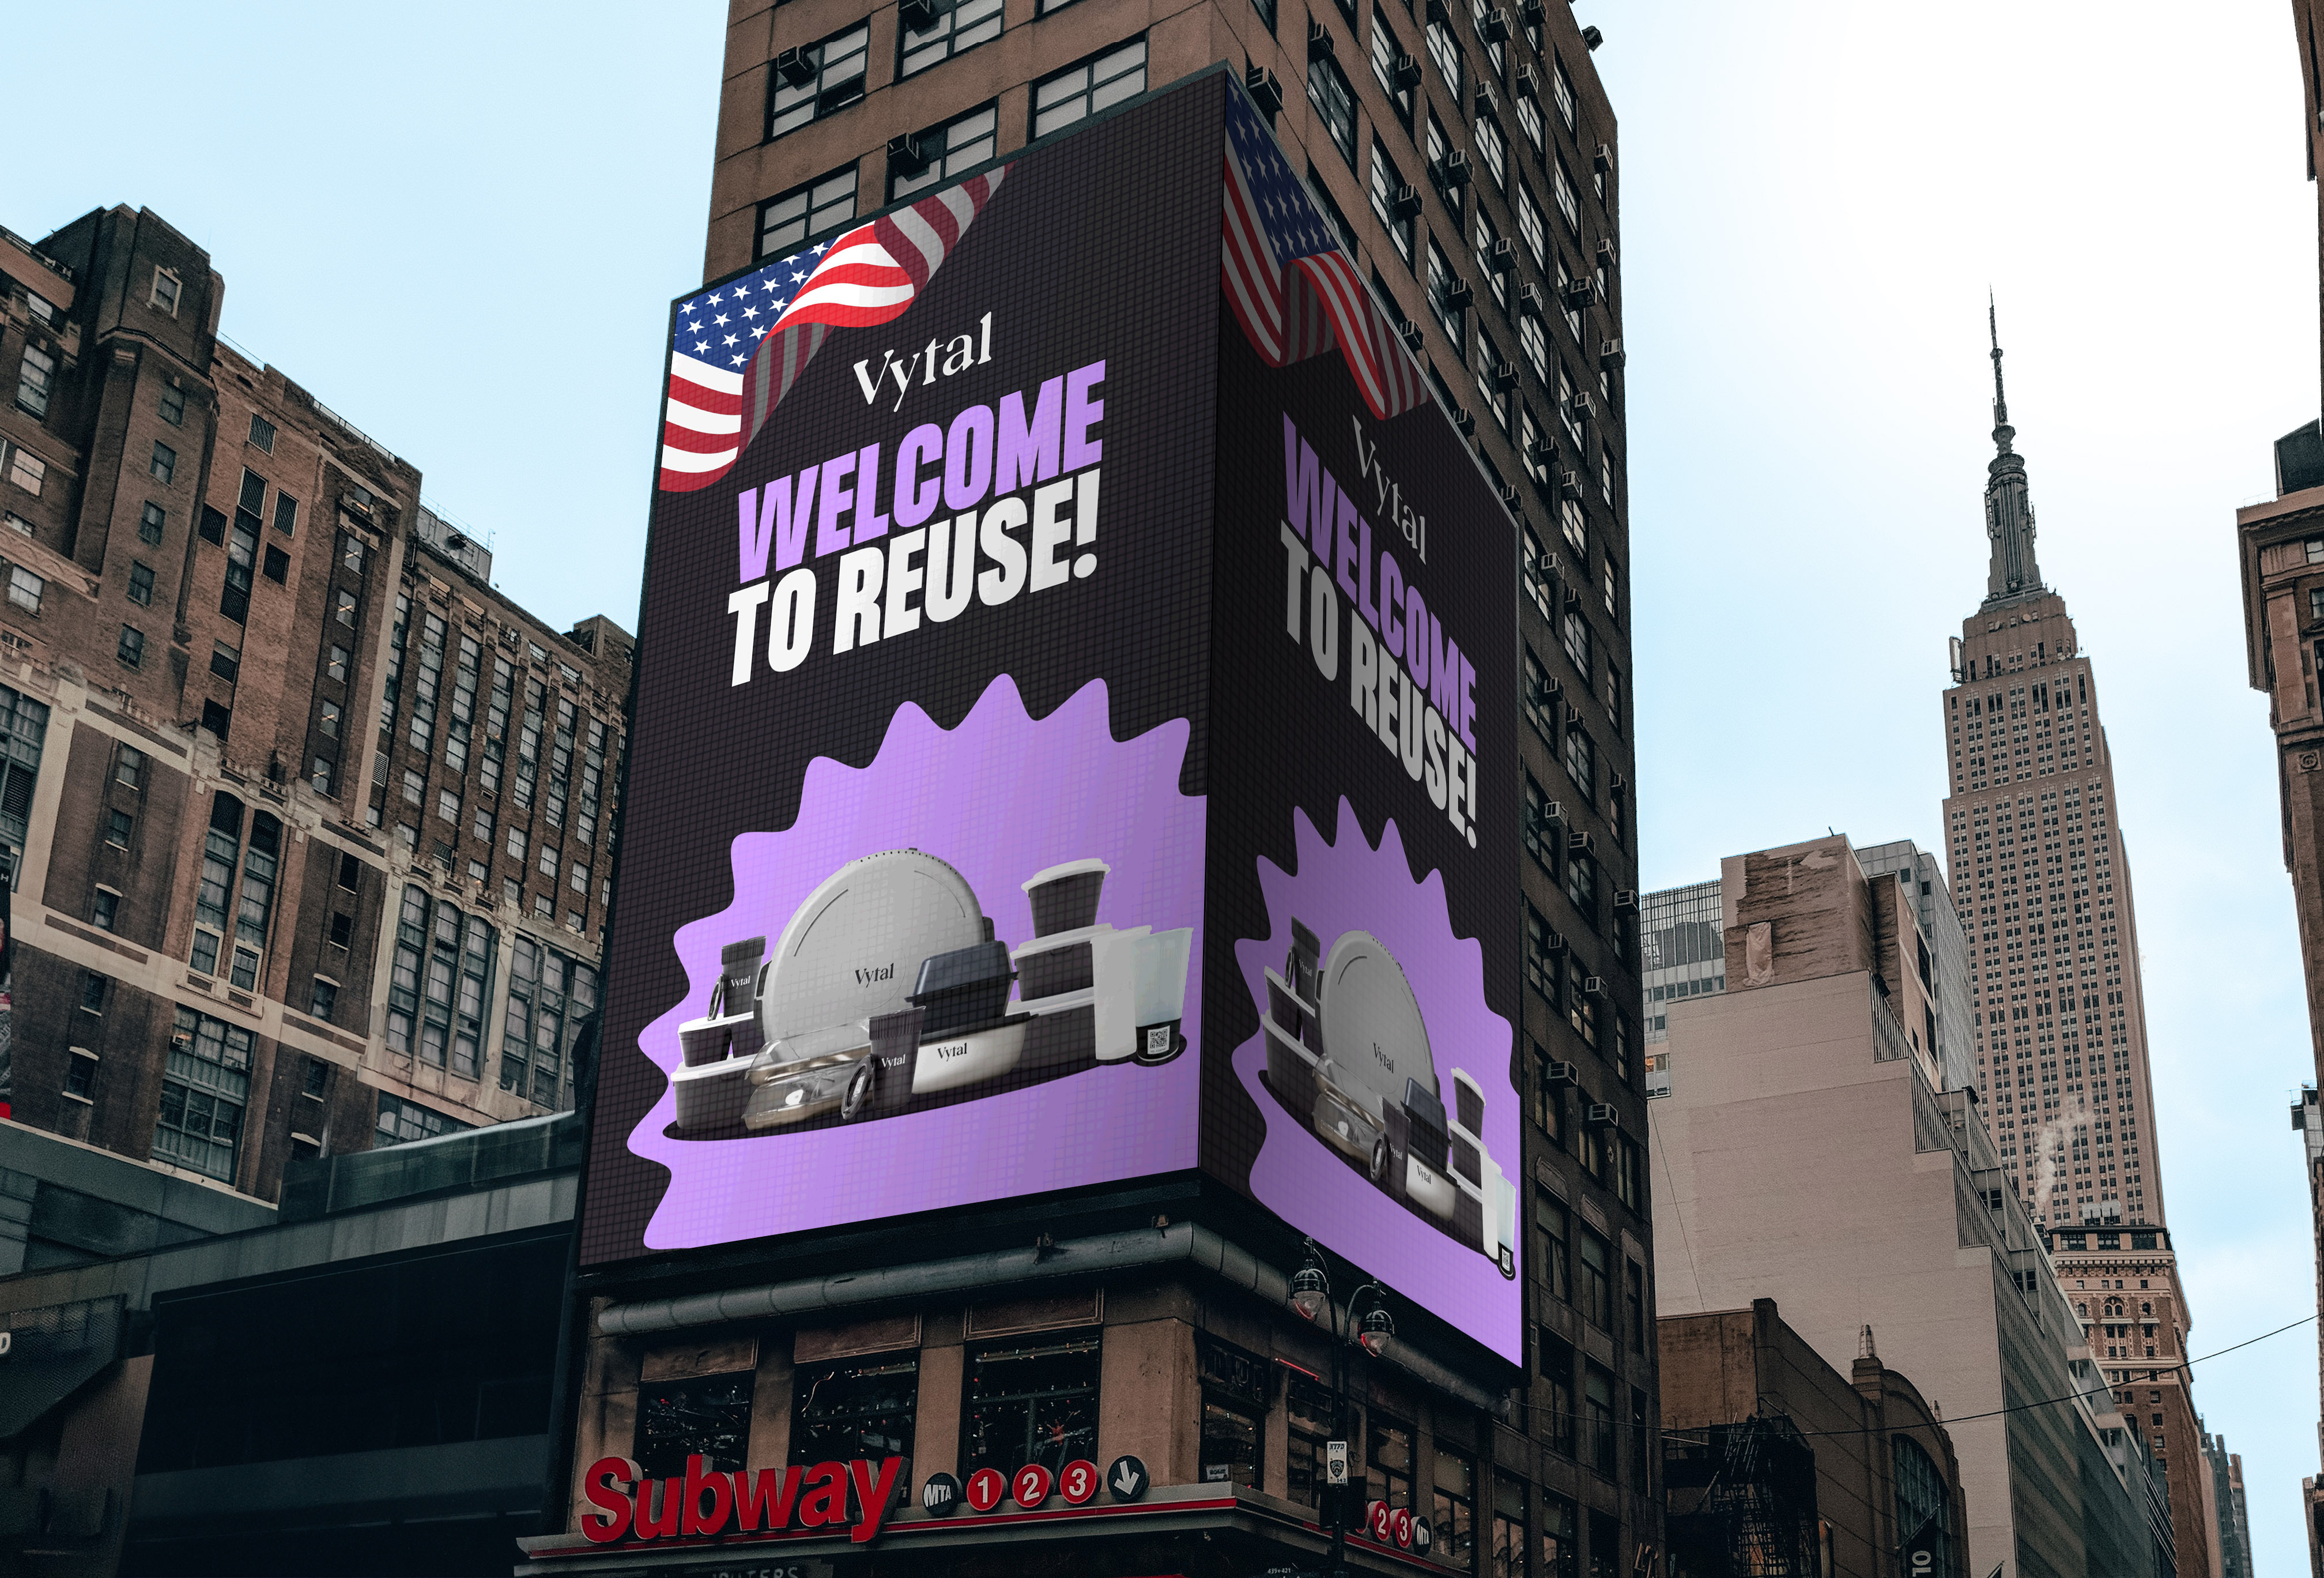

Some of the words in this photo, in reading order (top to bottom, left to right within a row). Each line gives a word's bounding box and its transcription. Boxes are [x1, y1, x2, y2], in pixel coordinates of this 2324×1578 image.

[853, 311, 991, 412] Vytal
[738, 359, 1106, 584] WELCOME
[1353, 415, 1427, 566] Vytal
[727, 568, 817, 687] TO
[833, 468, 1100, 655] REUSE!
[1283, 410, 1477, 756] WELCOME
[1281, 519, 1338, 682] TO
[1351, 608, 1477, 849] REUSE!
[731, 975, 750, 989] Vytal
[855, 962, 894, 988] Vytal
[881, 1054, 906, 1070] Vytal
[937, 1042, 967, 1062] Vytal
[1373, 1042, 1394, 1074] Vytal
[1390, 1143, 1402, 1161] Vytal
[1417, 1165, 1431, 1185] Vytal
[582, 1454, 902, 1543] Subway
[923, 1484, 952, 1508] MTA
[977, 1476, 989, 1503] 1
[1022, 1472, 1040, 1501] 2
[1069, 1467, 1088, 1496] 3
[1378, 1508, 1387, 1535] 2
[1399, 1516, 1408, 1541] 3
[1417, 1524, 1429, 1545] MTA
